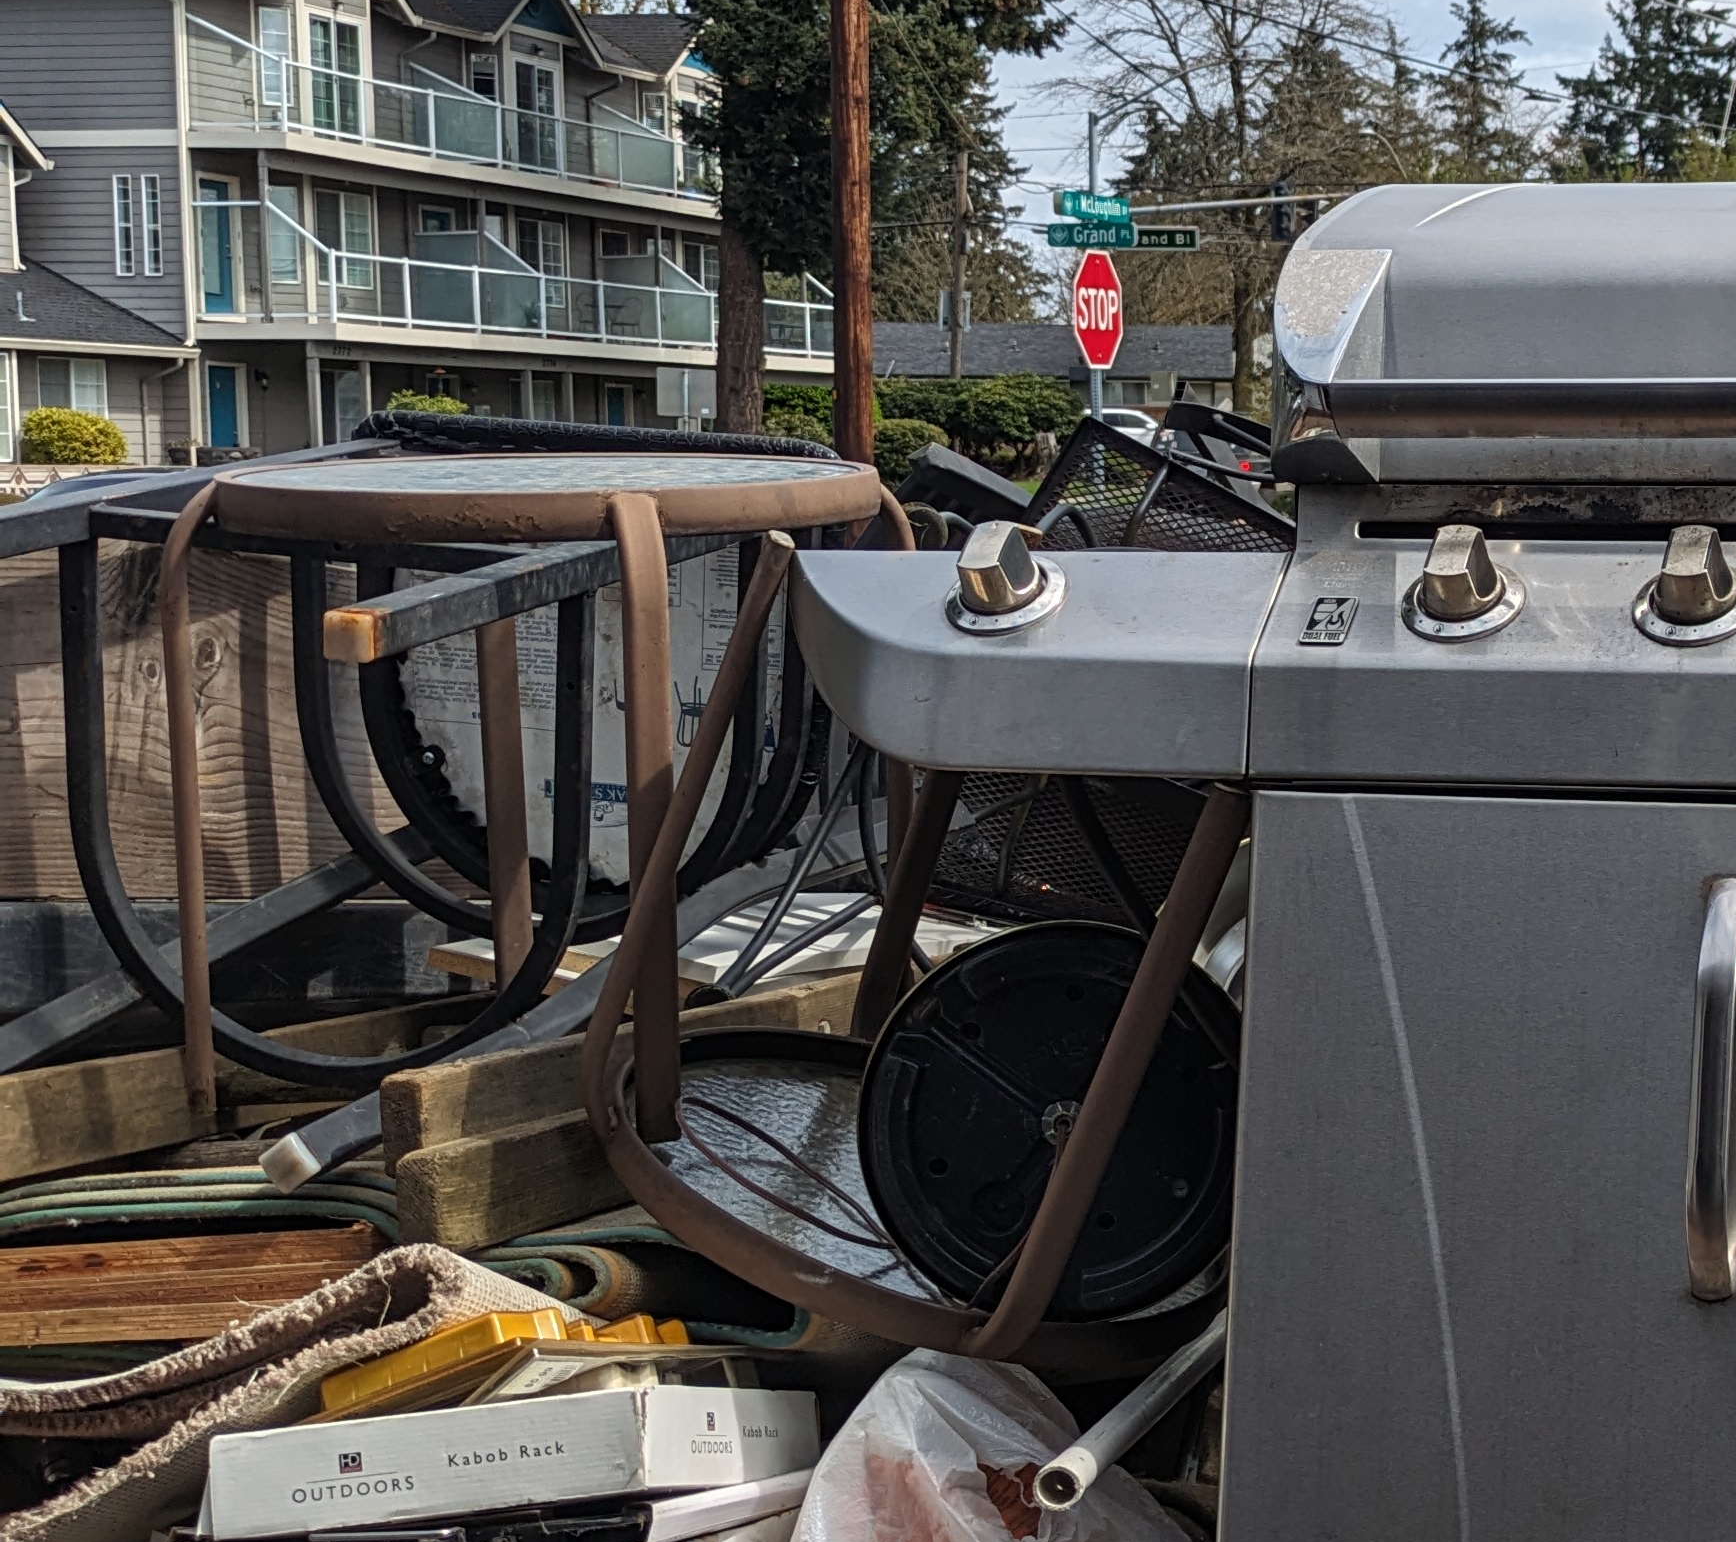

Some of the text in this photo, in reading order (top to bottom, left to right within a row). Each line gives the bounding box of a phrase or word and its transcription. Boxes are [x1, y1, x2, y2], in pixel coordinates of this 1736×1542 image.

[1080, 194, 1121, 221] McLoughlin
[1073, 226, 1116, 244] Grand
[1138, 233, 1168, 245] and
[1078, 287, 1118, 331] STOP
[1302, 631, 1322, 641] DUAL
[607, 788, 627, 801] AK
[742, 1425, 779, 1438] Kabob Rack
[447, 1441, 565, 1468] Kabob Rack
[691, 1440, 733, 1454] OUTDOORS
[340, 1453, 360, 1468] HD
[292, 1475, 414, 1503] OUTDOORS
